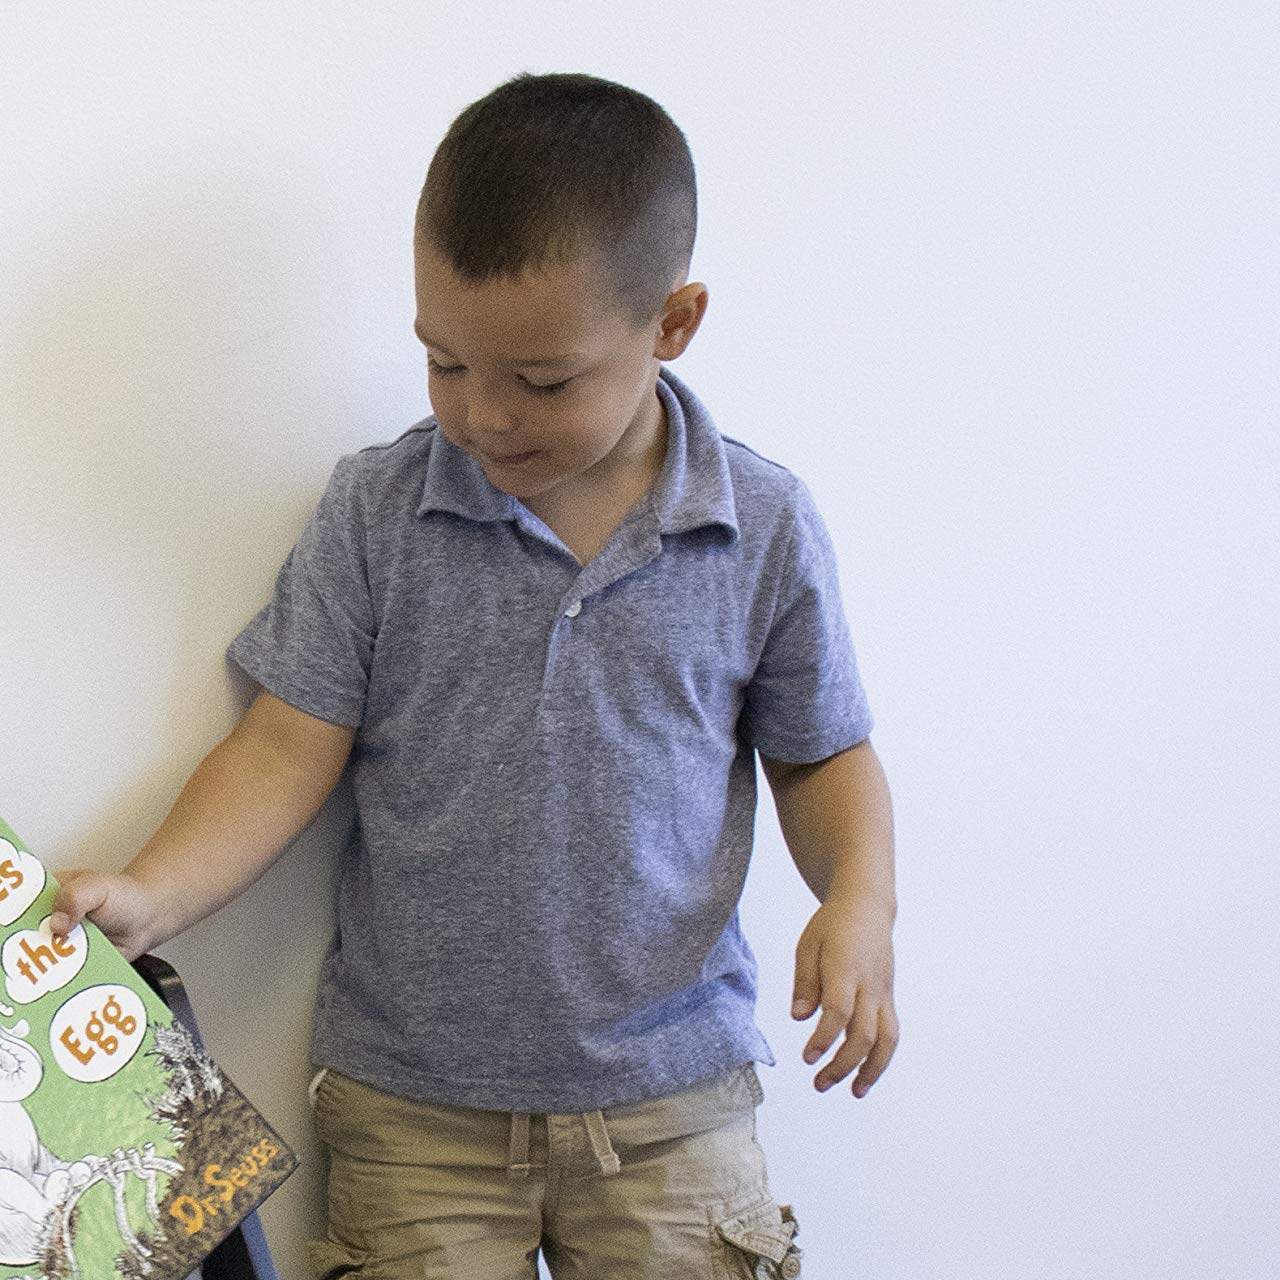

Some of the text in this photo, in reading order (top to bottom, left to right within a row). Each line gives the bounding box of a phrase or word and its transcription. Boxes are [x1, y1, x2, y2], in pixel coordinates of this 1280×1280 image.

[17, 932, 76, 985] the
[59, 994, 137, 1066] Egg
[204, 1138, 279, 1202] Seuss
